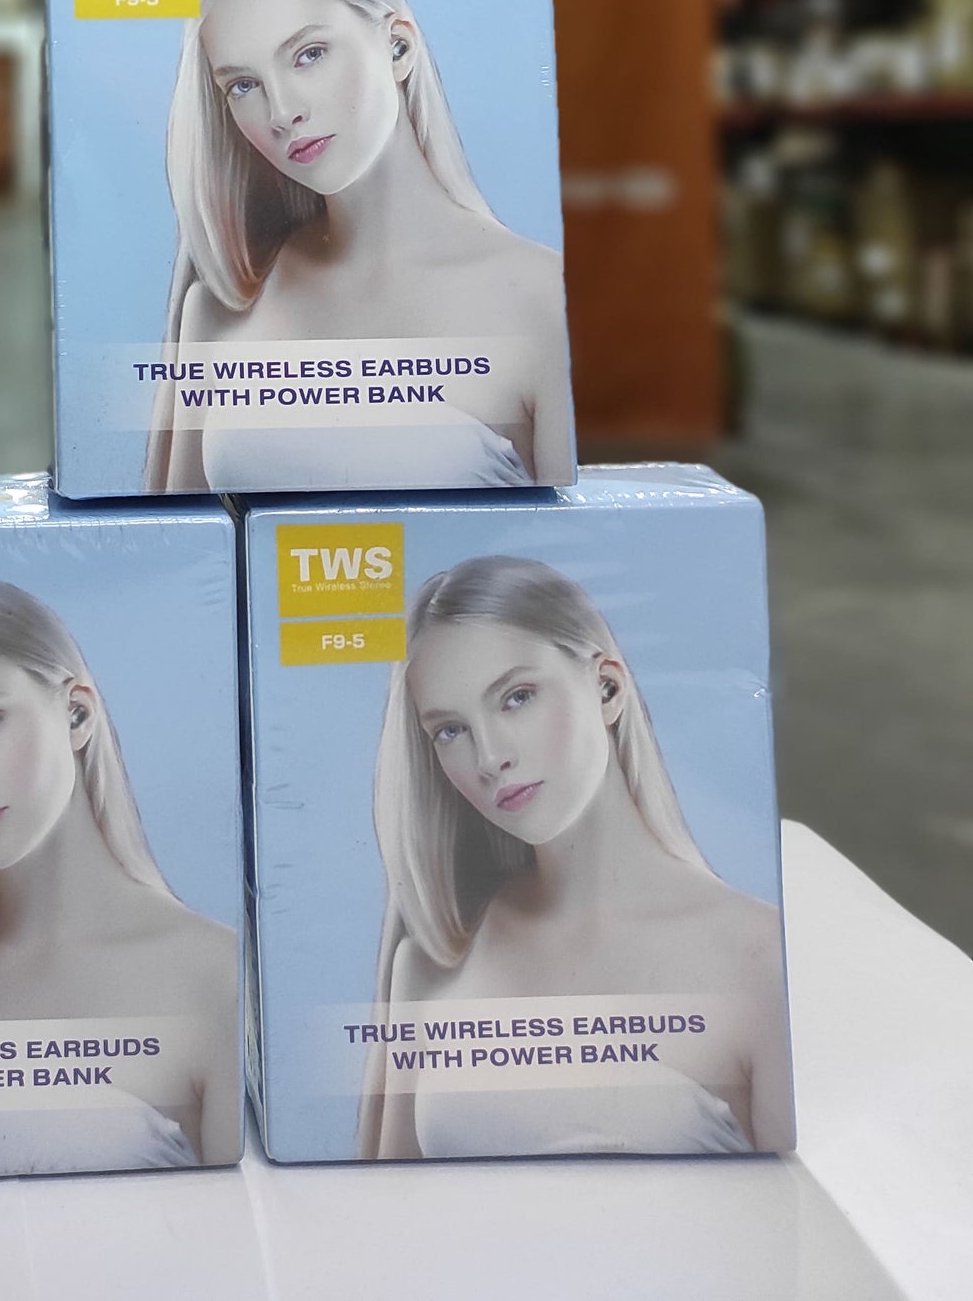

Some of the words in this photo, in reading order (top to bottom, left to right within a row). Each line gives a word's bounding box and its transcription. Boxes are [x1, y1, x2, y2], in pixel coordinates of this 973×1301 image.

[133, 363, 204, 381] TRUE
[213, 360, 352, 380] WIRELESS
[361, 357, 490, 376] EARBUDS
[181, 389, 250, 407] WITH
[260, 387, 360, 405] POWER
[368, 385, 445, 403] BANK
[290, 547, 392, 581] TWS
[316, 583, 355, 591] Wireless
[322, 634, 364, 650] F9-5
[344, 1023, 415, 1043] TRUE
[425, 1018, 563, 1040] WIRELESS
[573, 1015, 706, 1036] EARBUDS
[27, 1037, 160, 1059] EARBUDS
[392, 1051, 462, 1069] WITH
[472, 1047, 572, 1067] POWER
[581, 1044, 659, 1063] BANK
[33, 1067, 112, 1086] BANK
